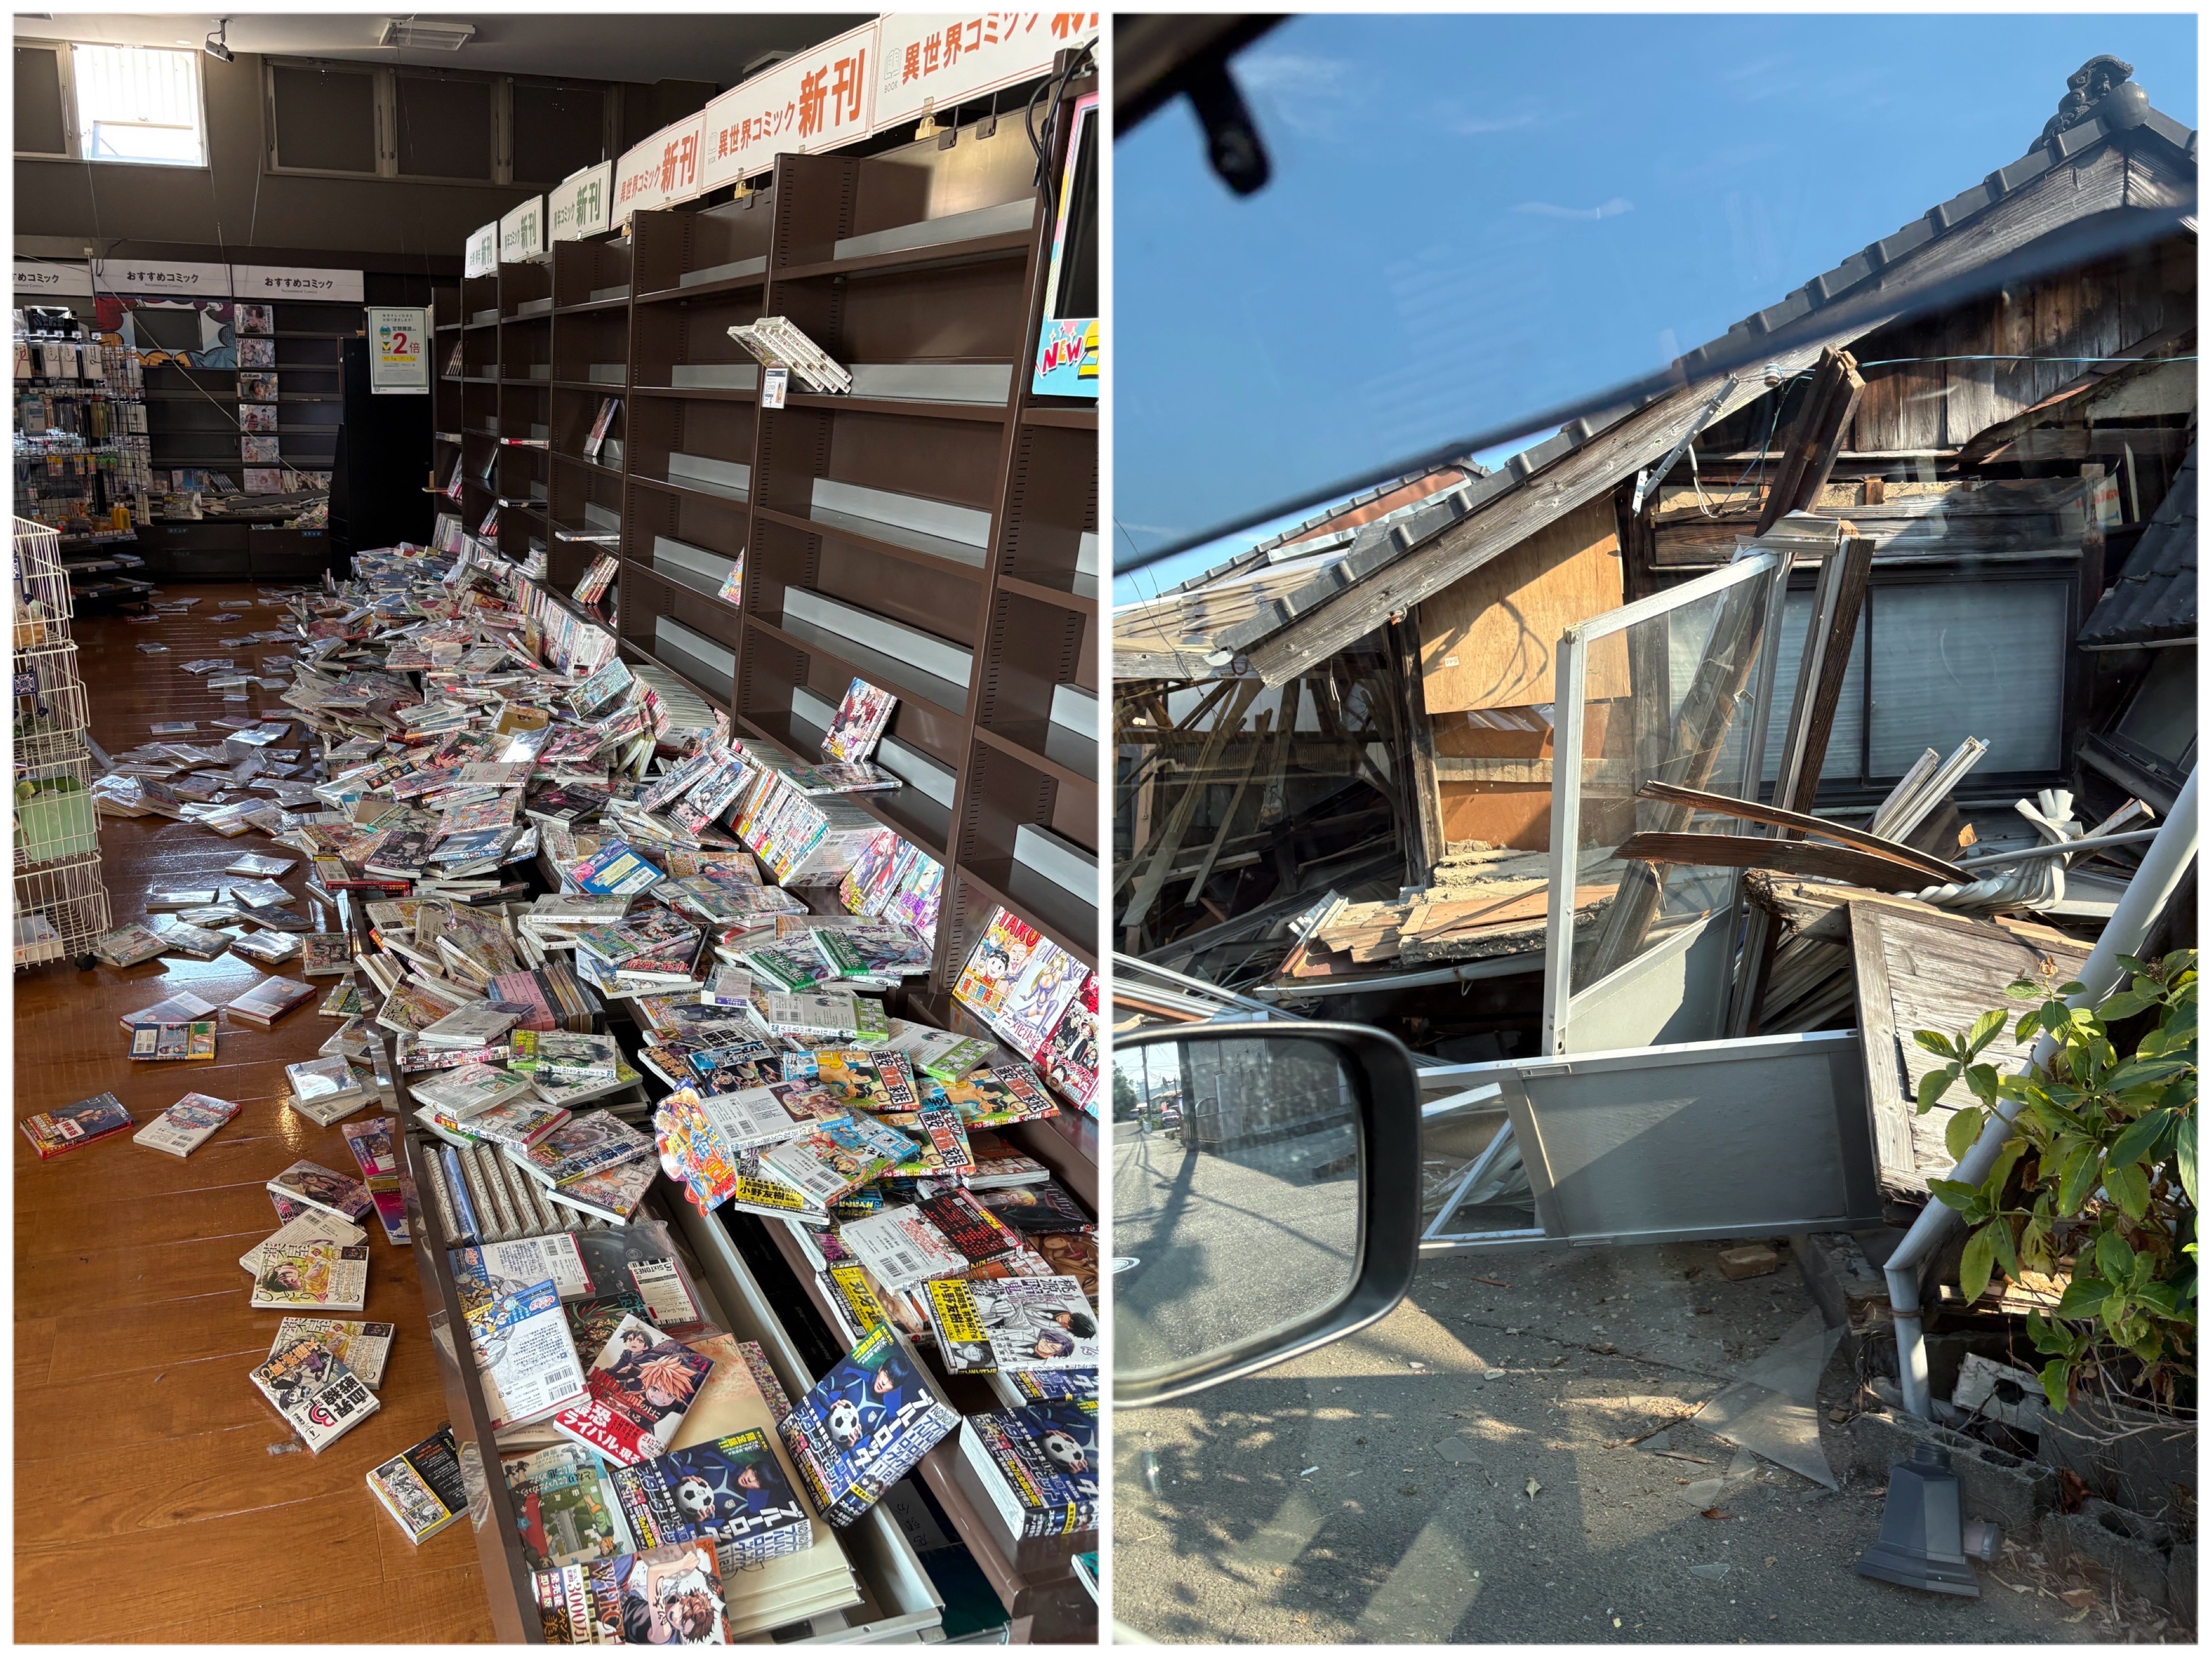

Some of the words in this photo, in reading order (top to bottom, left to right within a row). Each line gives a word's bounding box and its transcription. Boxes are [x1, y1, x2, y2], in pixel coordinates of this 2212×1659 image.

[718, 100, 795, 159] 異世界コミック
[798, 48, 866, 139] 新刊
[885, 80, 898, 93] BOOK
[660, 130, 699, 193] 新刊
[576, 178, 601, 227] 新刊
[521, 210, 536, 250] 新刊
[127, 271, 199, 282] おすすめコミック
[265, 277, 333, 288] おすすめコミック
[393, 333, 408, 354] 2
[409, 342, 420, 354] 倍
[1042, 336, 1083, 375] NEW
[739, 1187, 784, 1200] 小野友樹
[633, 1264, 664, 1274] SixTONES
[690, 1355, 709, 1371] 24
[321, 1375, 359, 1406] 戦線
[334, 1386, 369, 1418] 血界
[564, 1410, 641, 1464] ライバル、現る
[855, 1388, 934, 1467] ブルーロック
[635, 1466, 678, 1544] スターターセッ
[538, 1574, 552, 1609] 即重版
[550, 1572, 564, 1607] 発売後
